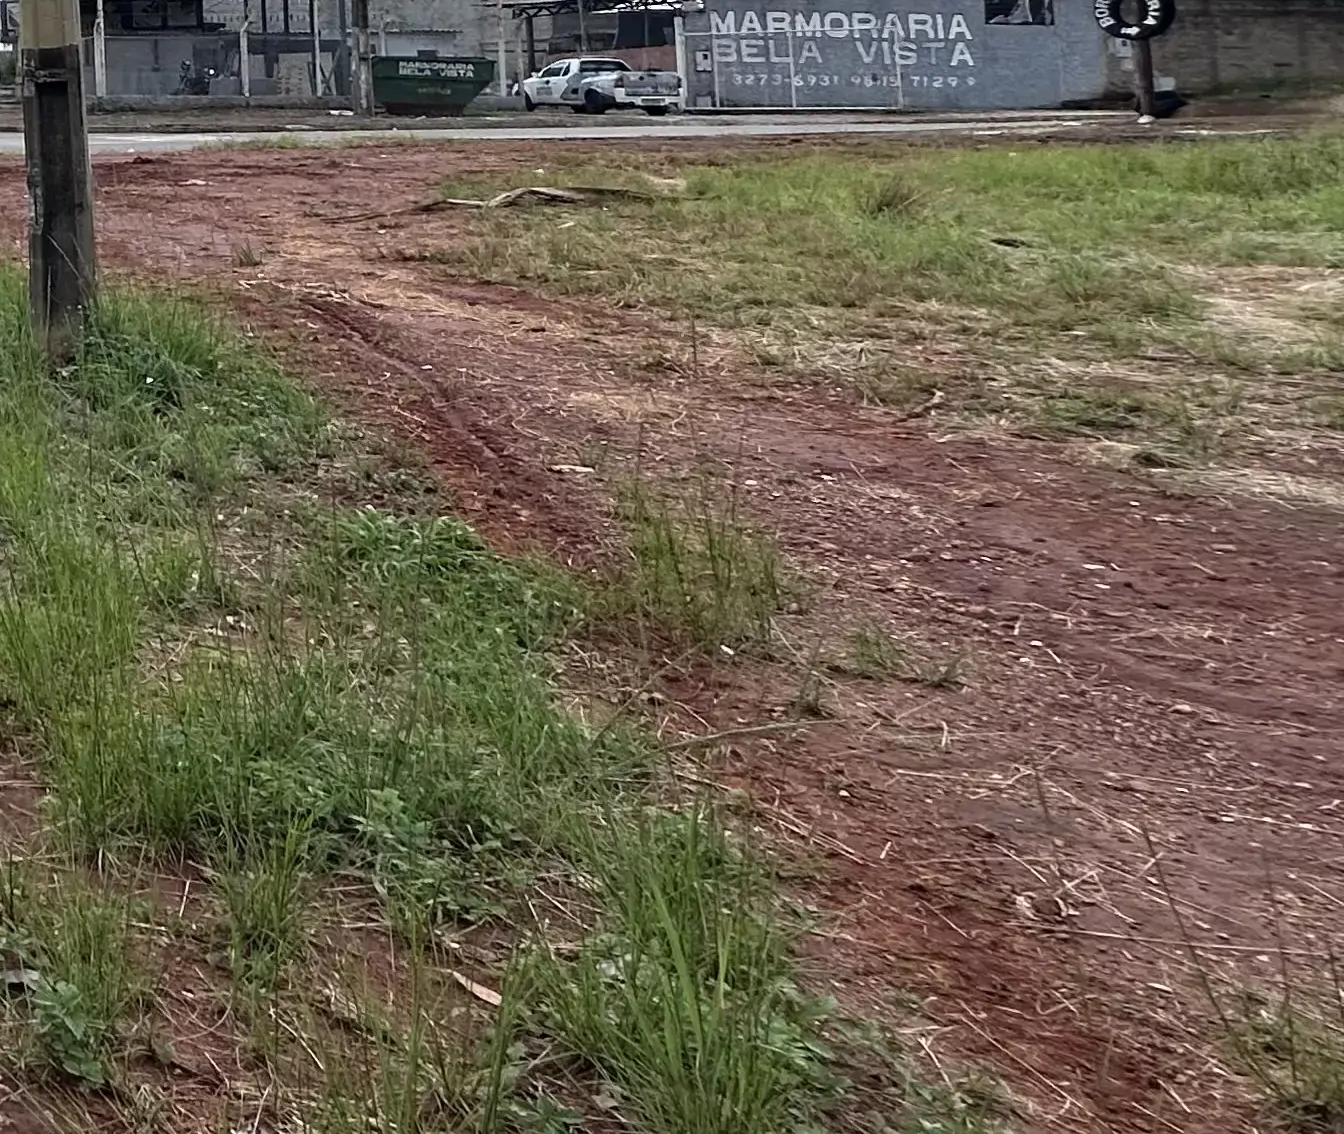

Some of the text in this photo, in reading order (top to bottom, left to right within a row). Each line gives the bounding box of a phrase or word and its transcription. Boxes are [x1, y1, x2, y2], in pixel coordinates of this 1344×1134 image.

[709, 9, 974, 41] MARMORARIA
[714, 38, 975, 66] BELA VISTA
